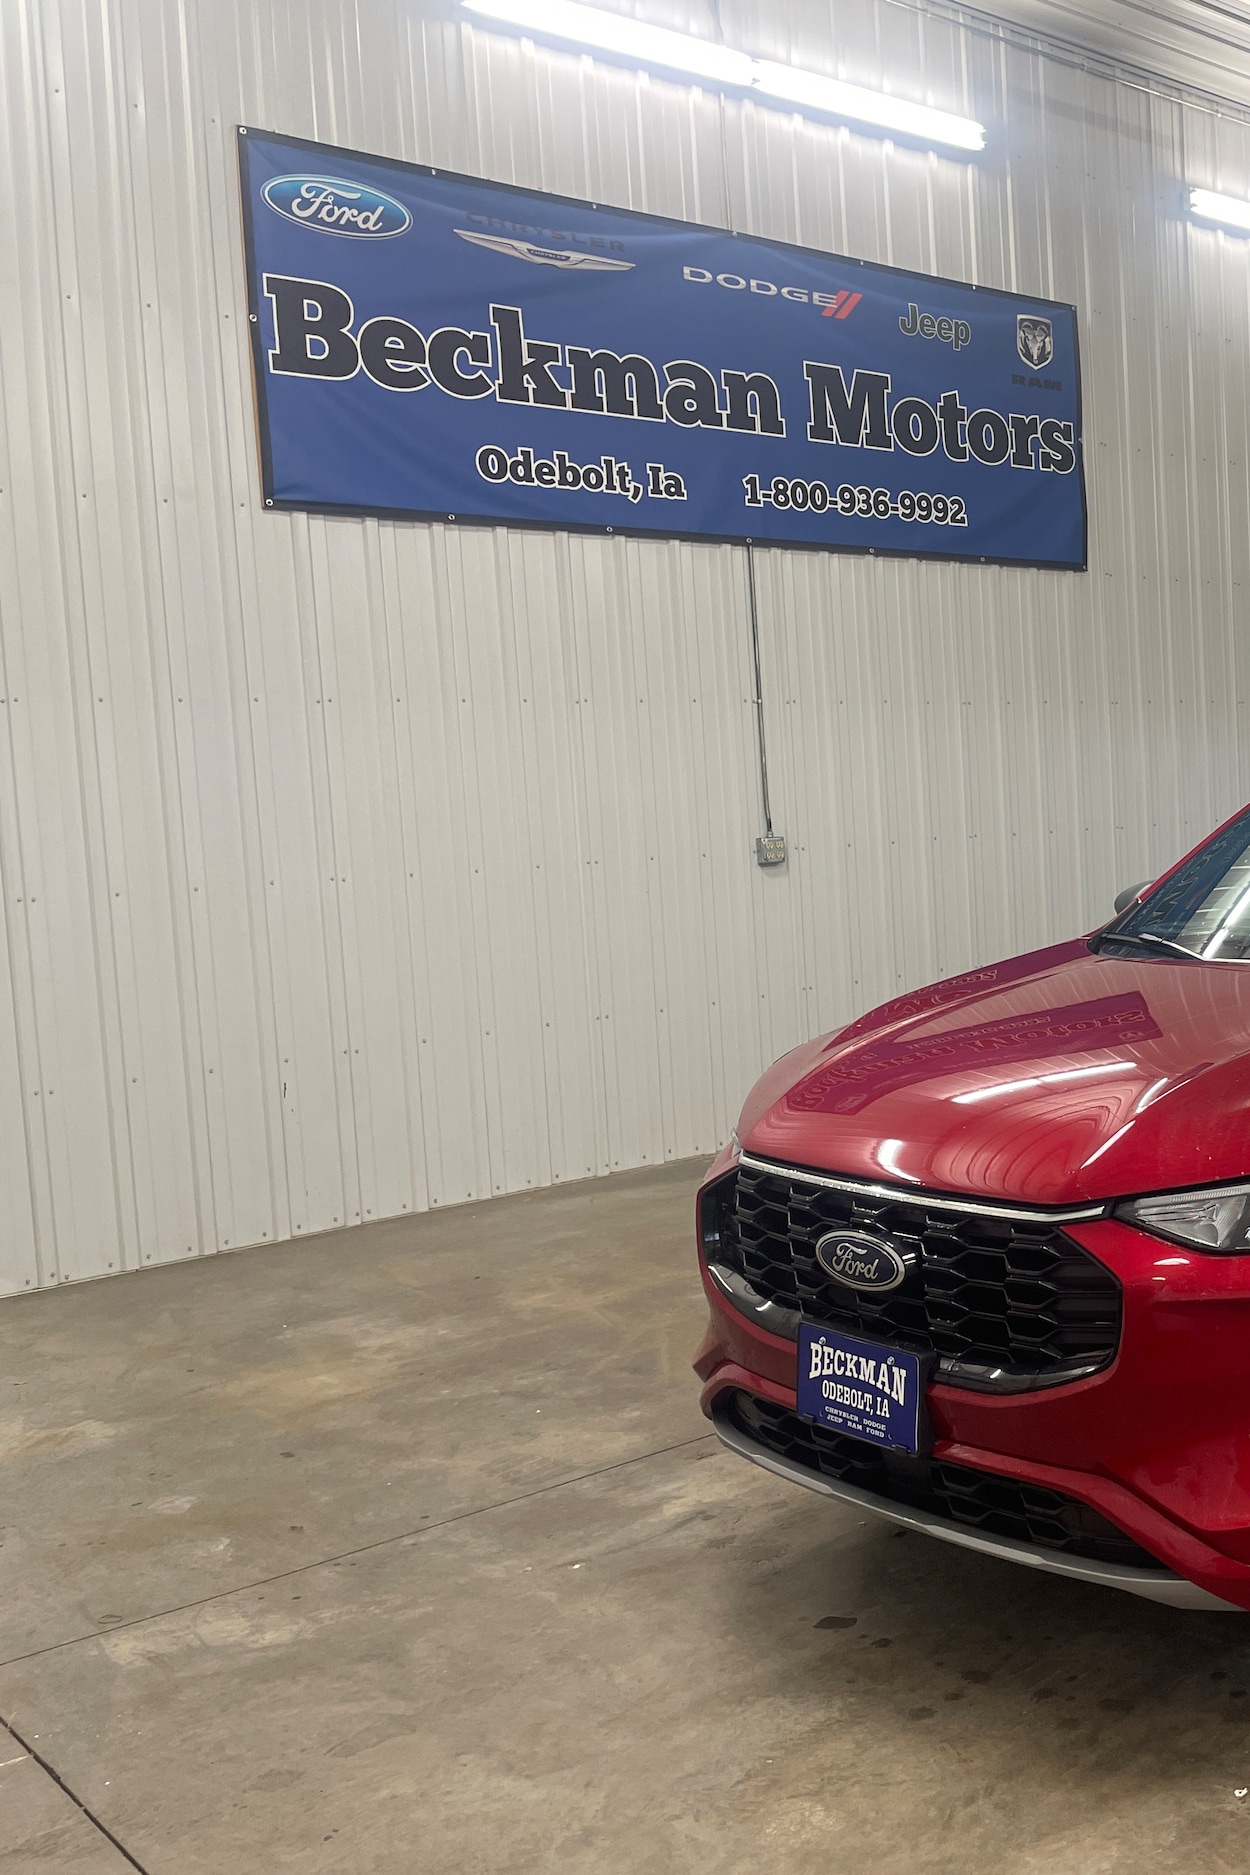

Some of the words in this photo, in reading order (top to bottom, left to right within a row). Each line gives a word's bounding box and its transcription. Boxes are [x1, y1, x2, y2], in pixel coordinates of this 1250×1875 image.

[291, 182, 385, 232] Ford
[465, 212, 626, 253] CHRYSLER
[682, 266, 840, 309] DODGE
[898, 303, 972, 351] Jeep
[262, 273, 786, 438] Beckman
[803, 360, 1076, 474] Motors
[1011, 374, 1062, 391] RAM
[475, 444, 643, 504] Odebolt,
[646, 463, 688, 501] Ia
[742, 474, 968, 527] 1-800-936-9992
[832, 1242, 879, 1280] Ford
[809, 1341, 907, 1406] BECKMAN
[822, 1380, 874, 1416] ODEBOLT,
[876, 1397, 890, 1418] IA
[825, 1405, 859, 1422] CHRYSLER
[863, 1418, 886, 1431] DODGE
[827, 1414, 843, 1424] JEEP
[847, 1421, 863, 1431] RAM
[865, 1427, 885, 1438] FORD
